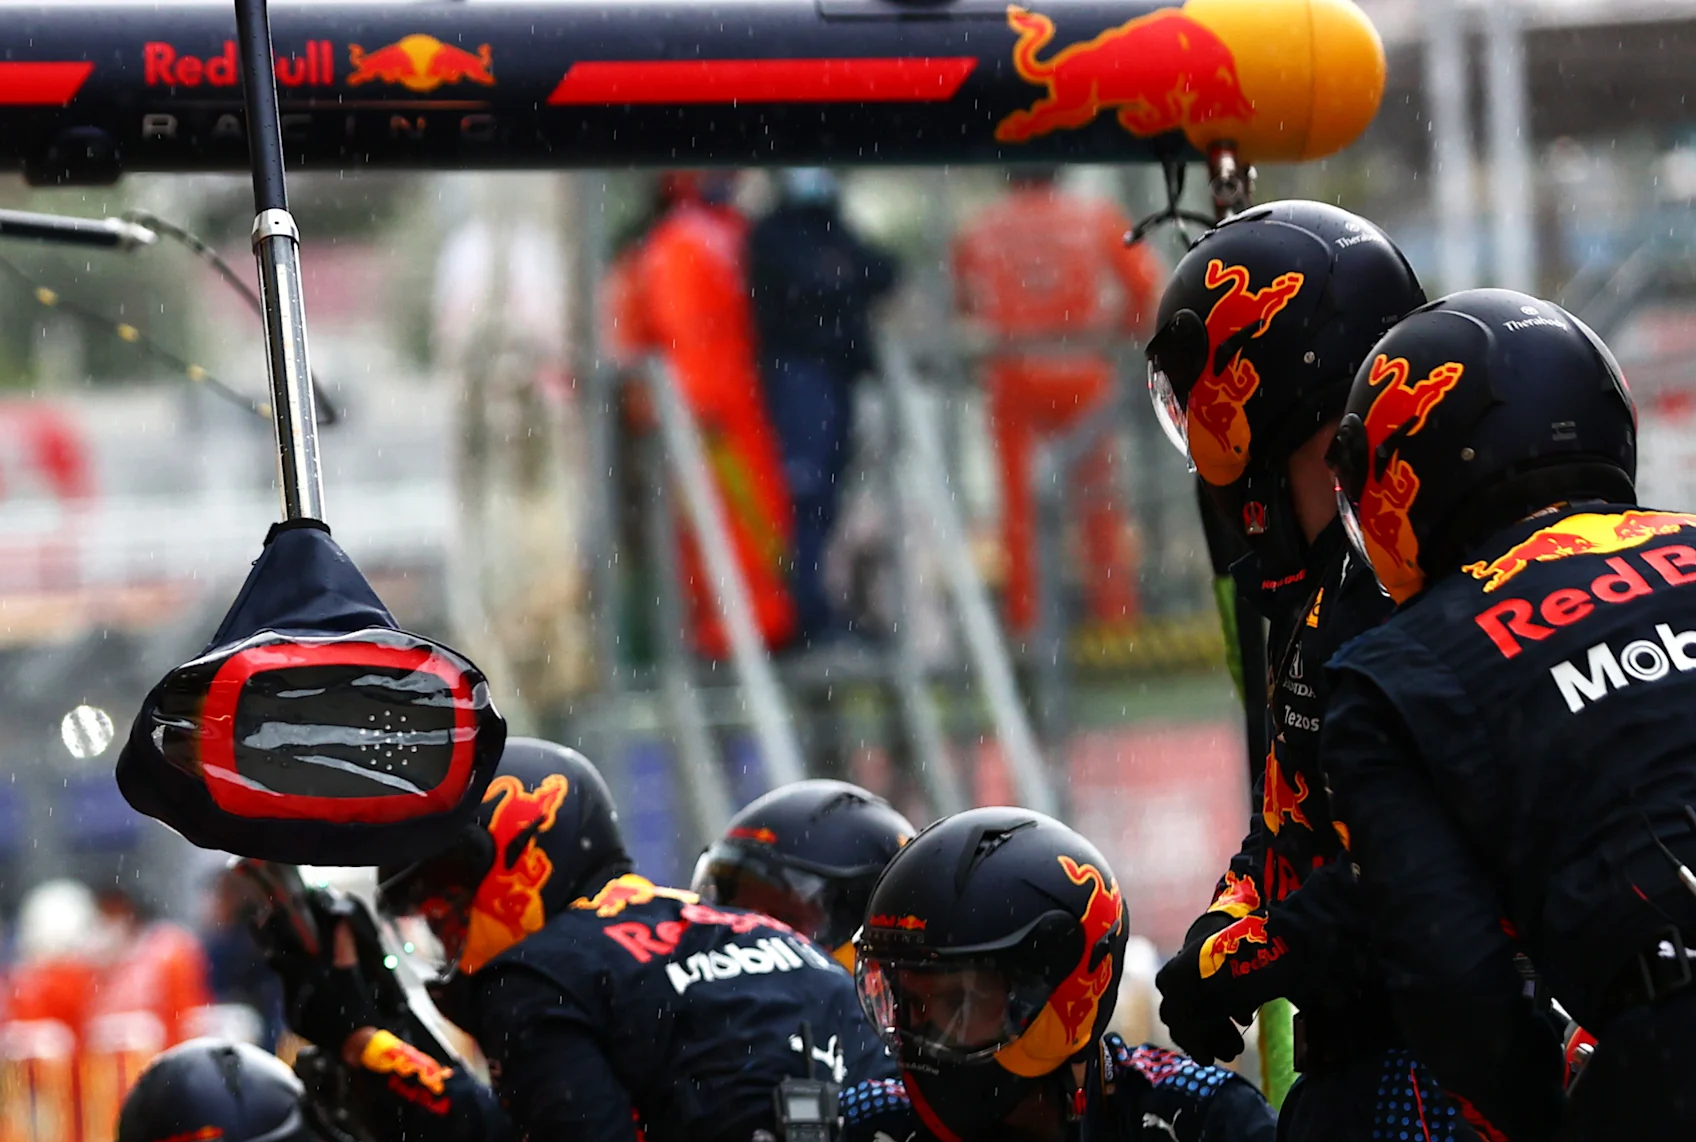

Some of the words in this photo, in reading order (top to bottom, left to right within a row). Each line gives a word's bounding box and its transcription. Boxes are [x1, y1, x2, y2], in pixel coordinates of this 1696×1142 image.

[144, 40, 238, 88] Red
[272, 40, 335, 88] ull
[1474, 556, 1654, 660] Red
[1283, 703, 1321, 732] Tezos
